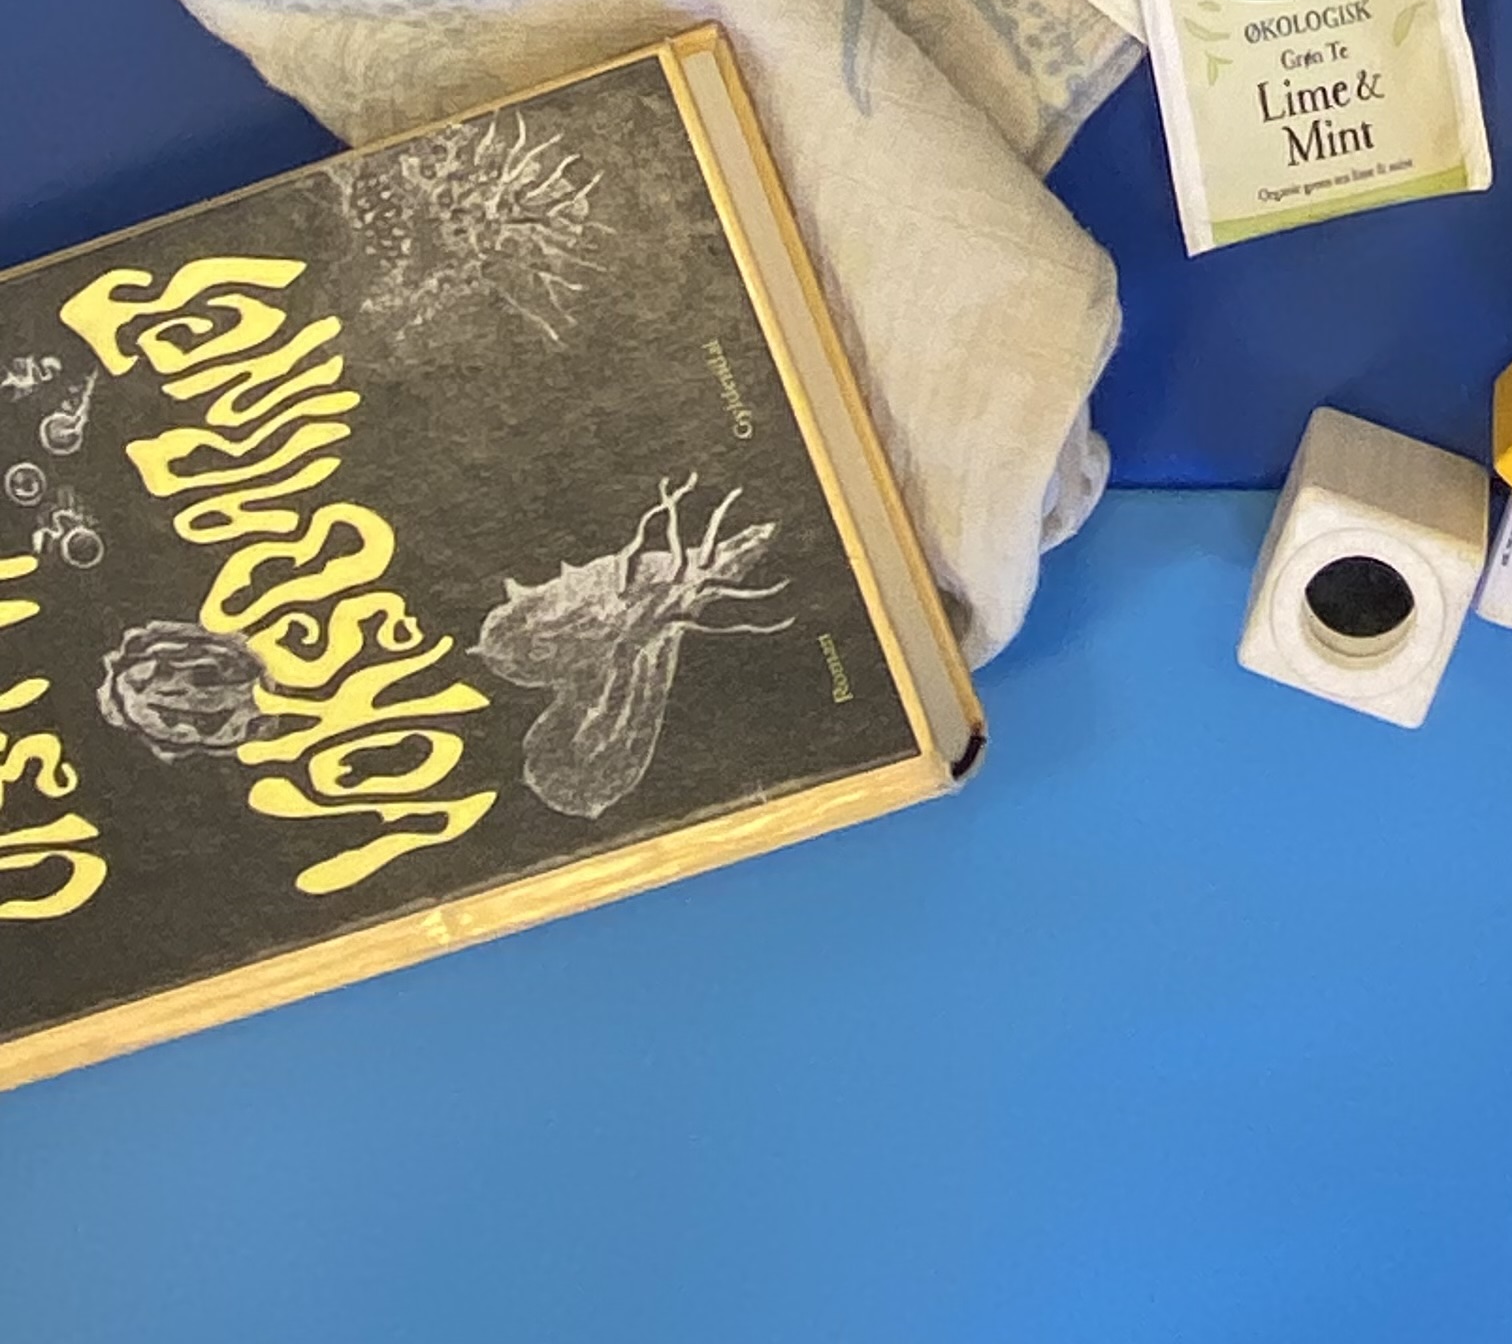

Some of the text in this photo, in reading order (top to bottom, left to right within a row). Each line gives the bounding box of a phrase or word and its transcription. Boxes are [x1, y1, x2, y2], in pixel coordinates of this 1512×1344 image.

[1257, 69, 1386, 123] Lime &
[1281, 119, 1375, 168] Mint
[818, 633, 857, 706] Roman
